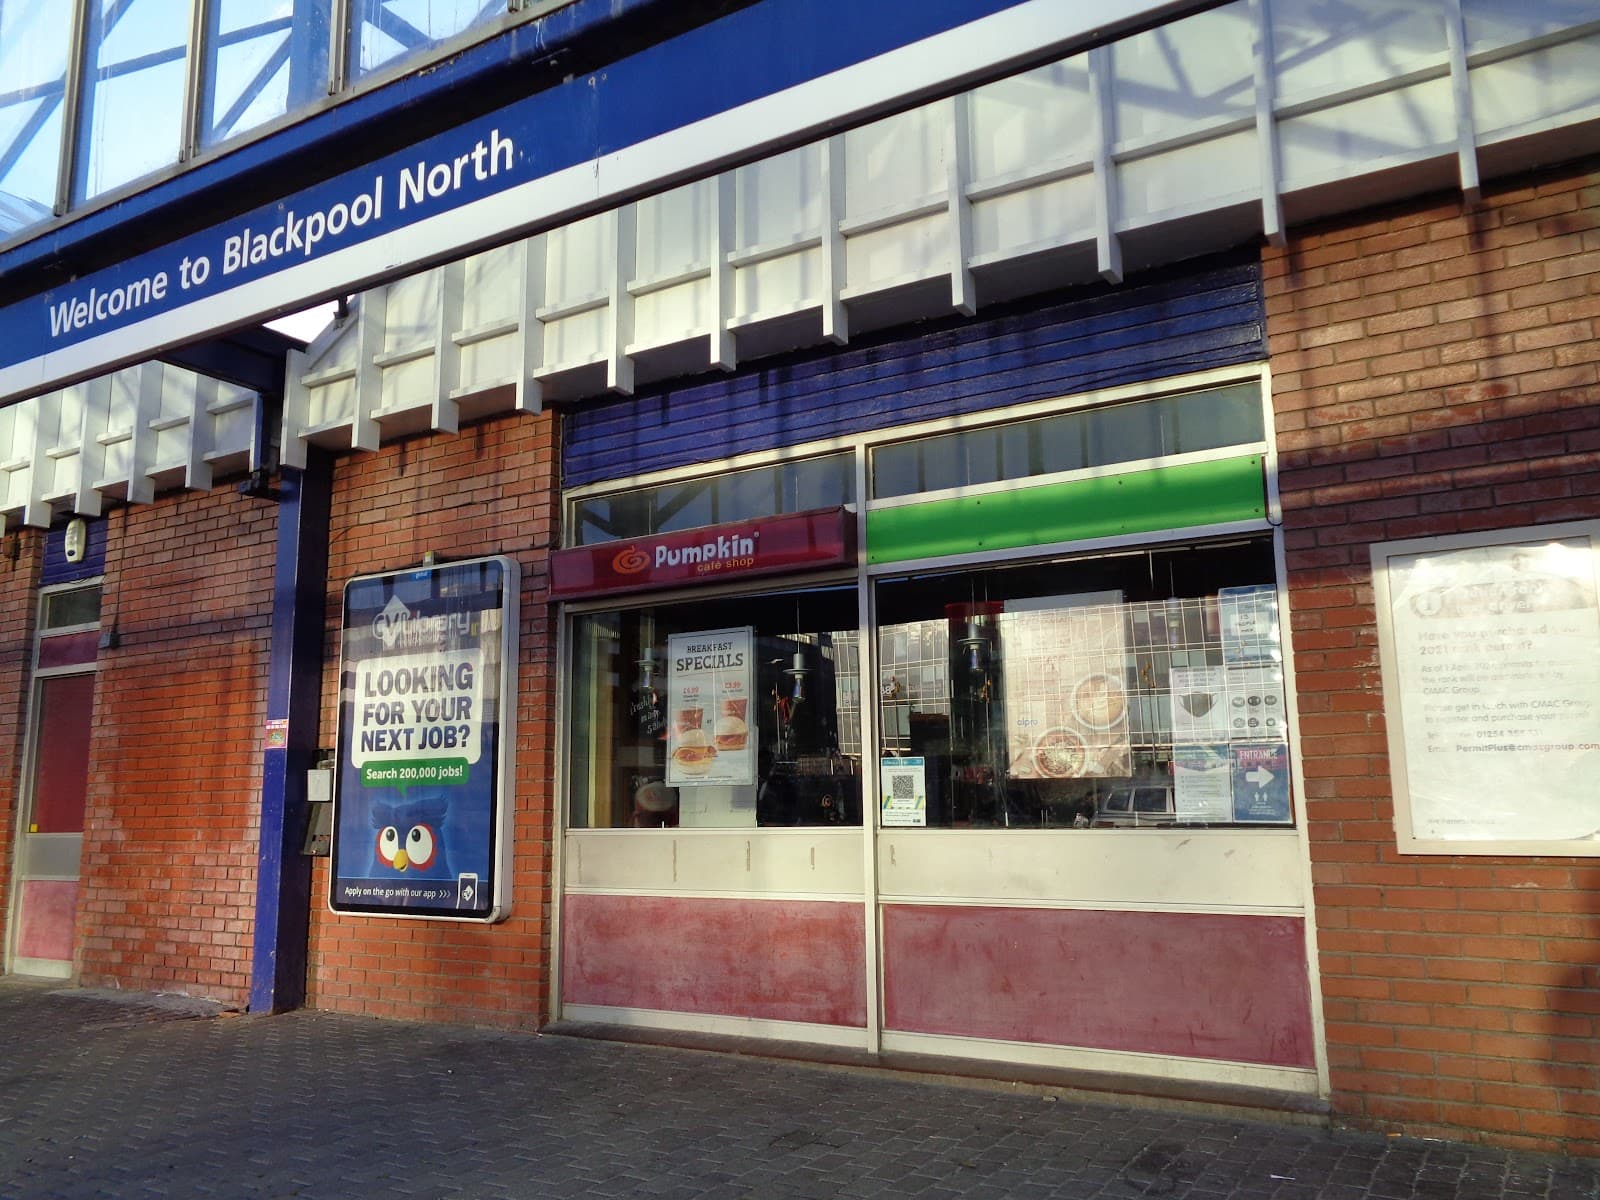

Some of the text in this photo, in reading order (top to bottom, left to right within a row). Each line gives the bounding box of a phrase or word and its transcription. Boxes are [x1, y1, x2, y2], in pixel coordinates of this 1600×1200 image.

[49, 129, 514, 337] Welcome to Blackpool North
[655, 533, 754, 568] Pumpkin
[697, 557, 754, 572] café shop
[687, 641, 733, 654] BREAKFAST
[676, 652, 744, 672] SPECIALS
[365, 662, 473, 697] LOOKING
[1452, 685, 1480, 696] Group
[363, 696, 473, 726] FOR YOUR
[1455, 703, 1470, 715] get
[1509, 701, 1529, 710] with
[1531, 699, 1561, 709] CMAC
[1017, 717, 1038, 728] alpro
[1472, 713, 1489, 722] and
[361, 724, 470, 752] NEXT JOB?
[1240, 750, 1278, 760] ENTRANCE
[366, 765, 463, 780] Search 200,000 jobs!
[345, 887, 362, 897] Apply
[373, 888, 384, 896] the
[385, 889, 394, 898] go
[423, 890, 436, 899] app
